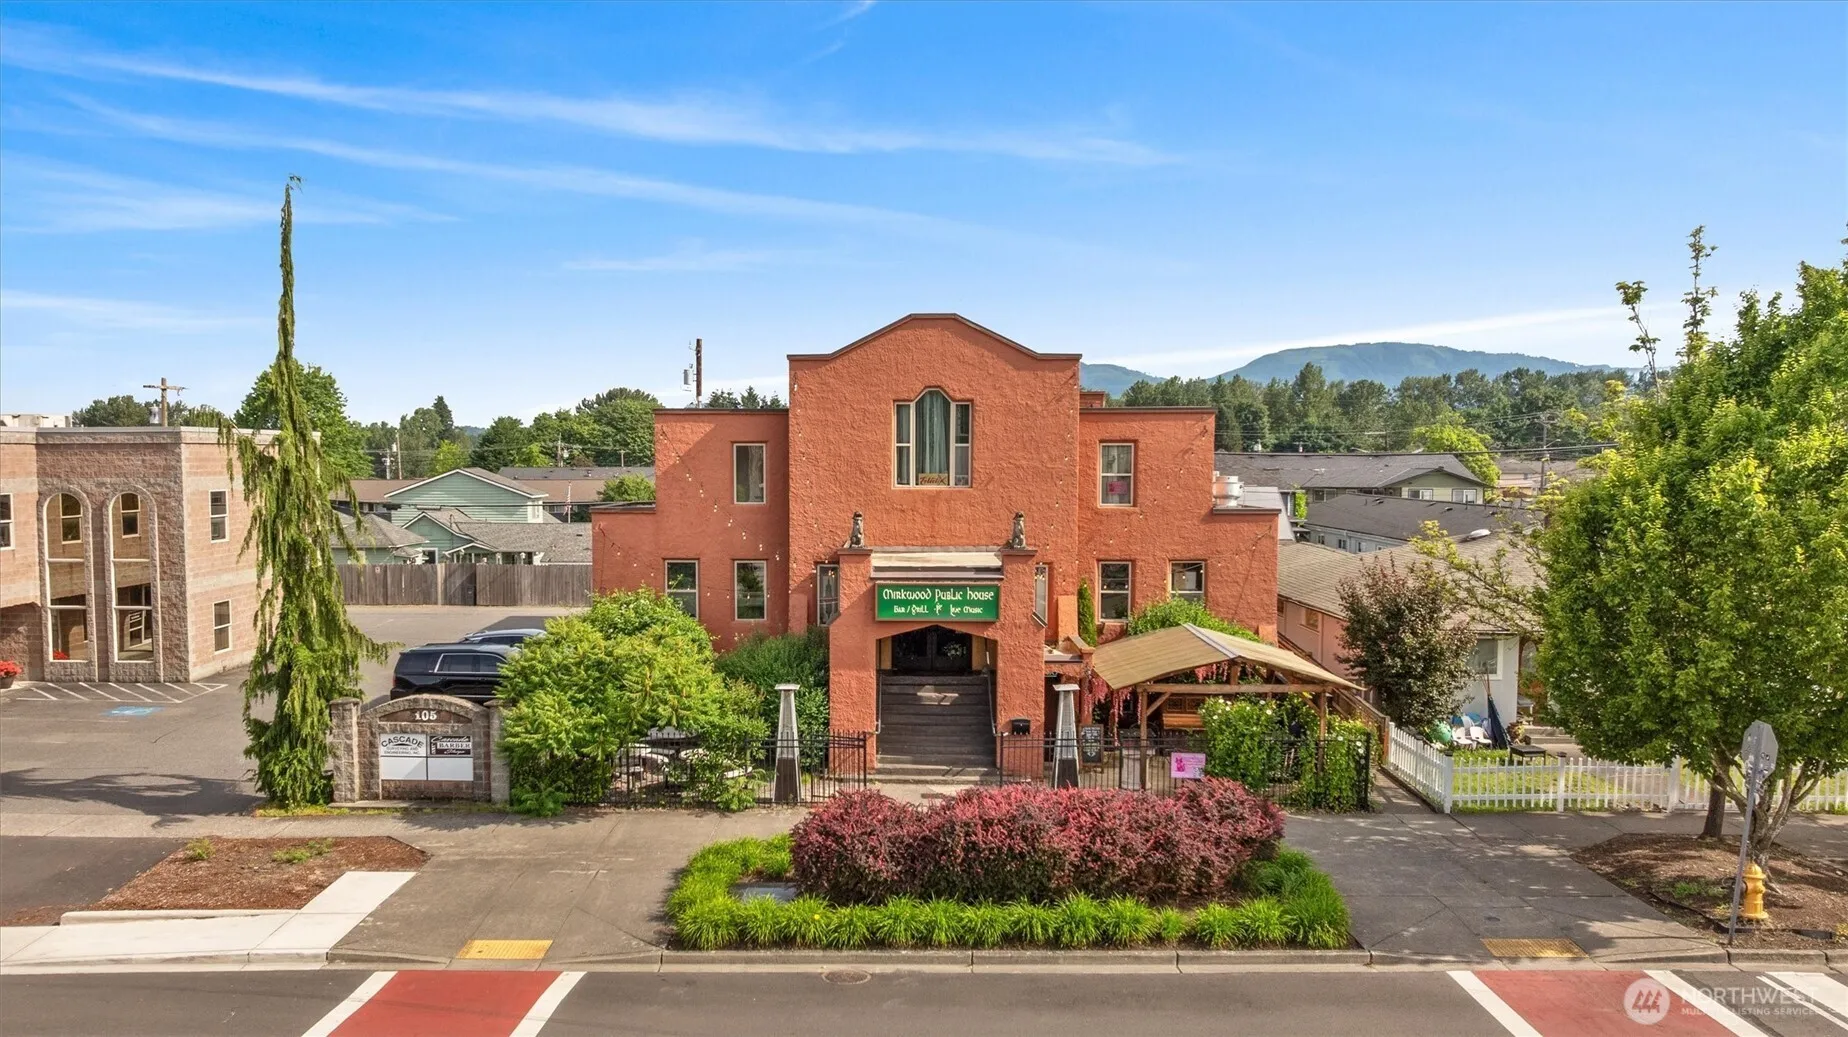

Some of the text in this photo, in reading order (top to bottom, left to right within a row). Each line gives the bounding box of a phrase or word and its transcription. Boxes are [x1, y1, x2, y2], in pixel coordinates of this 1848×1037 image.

[911, 604, 929, 615] Grill
[963, 605, 984, 614] Music
[415, 710, 437, 720] 105
[381, 736, 424, 748] CASCADE
